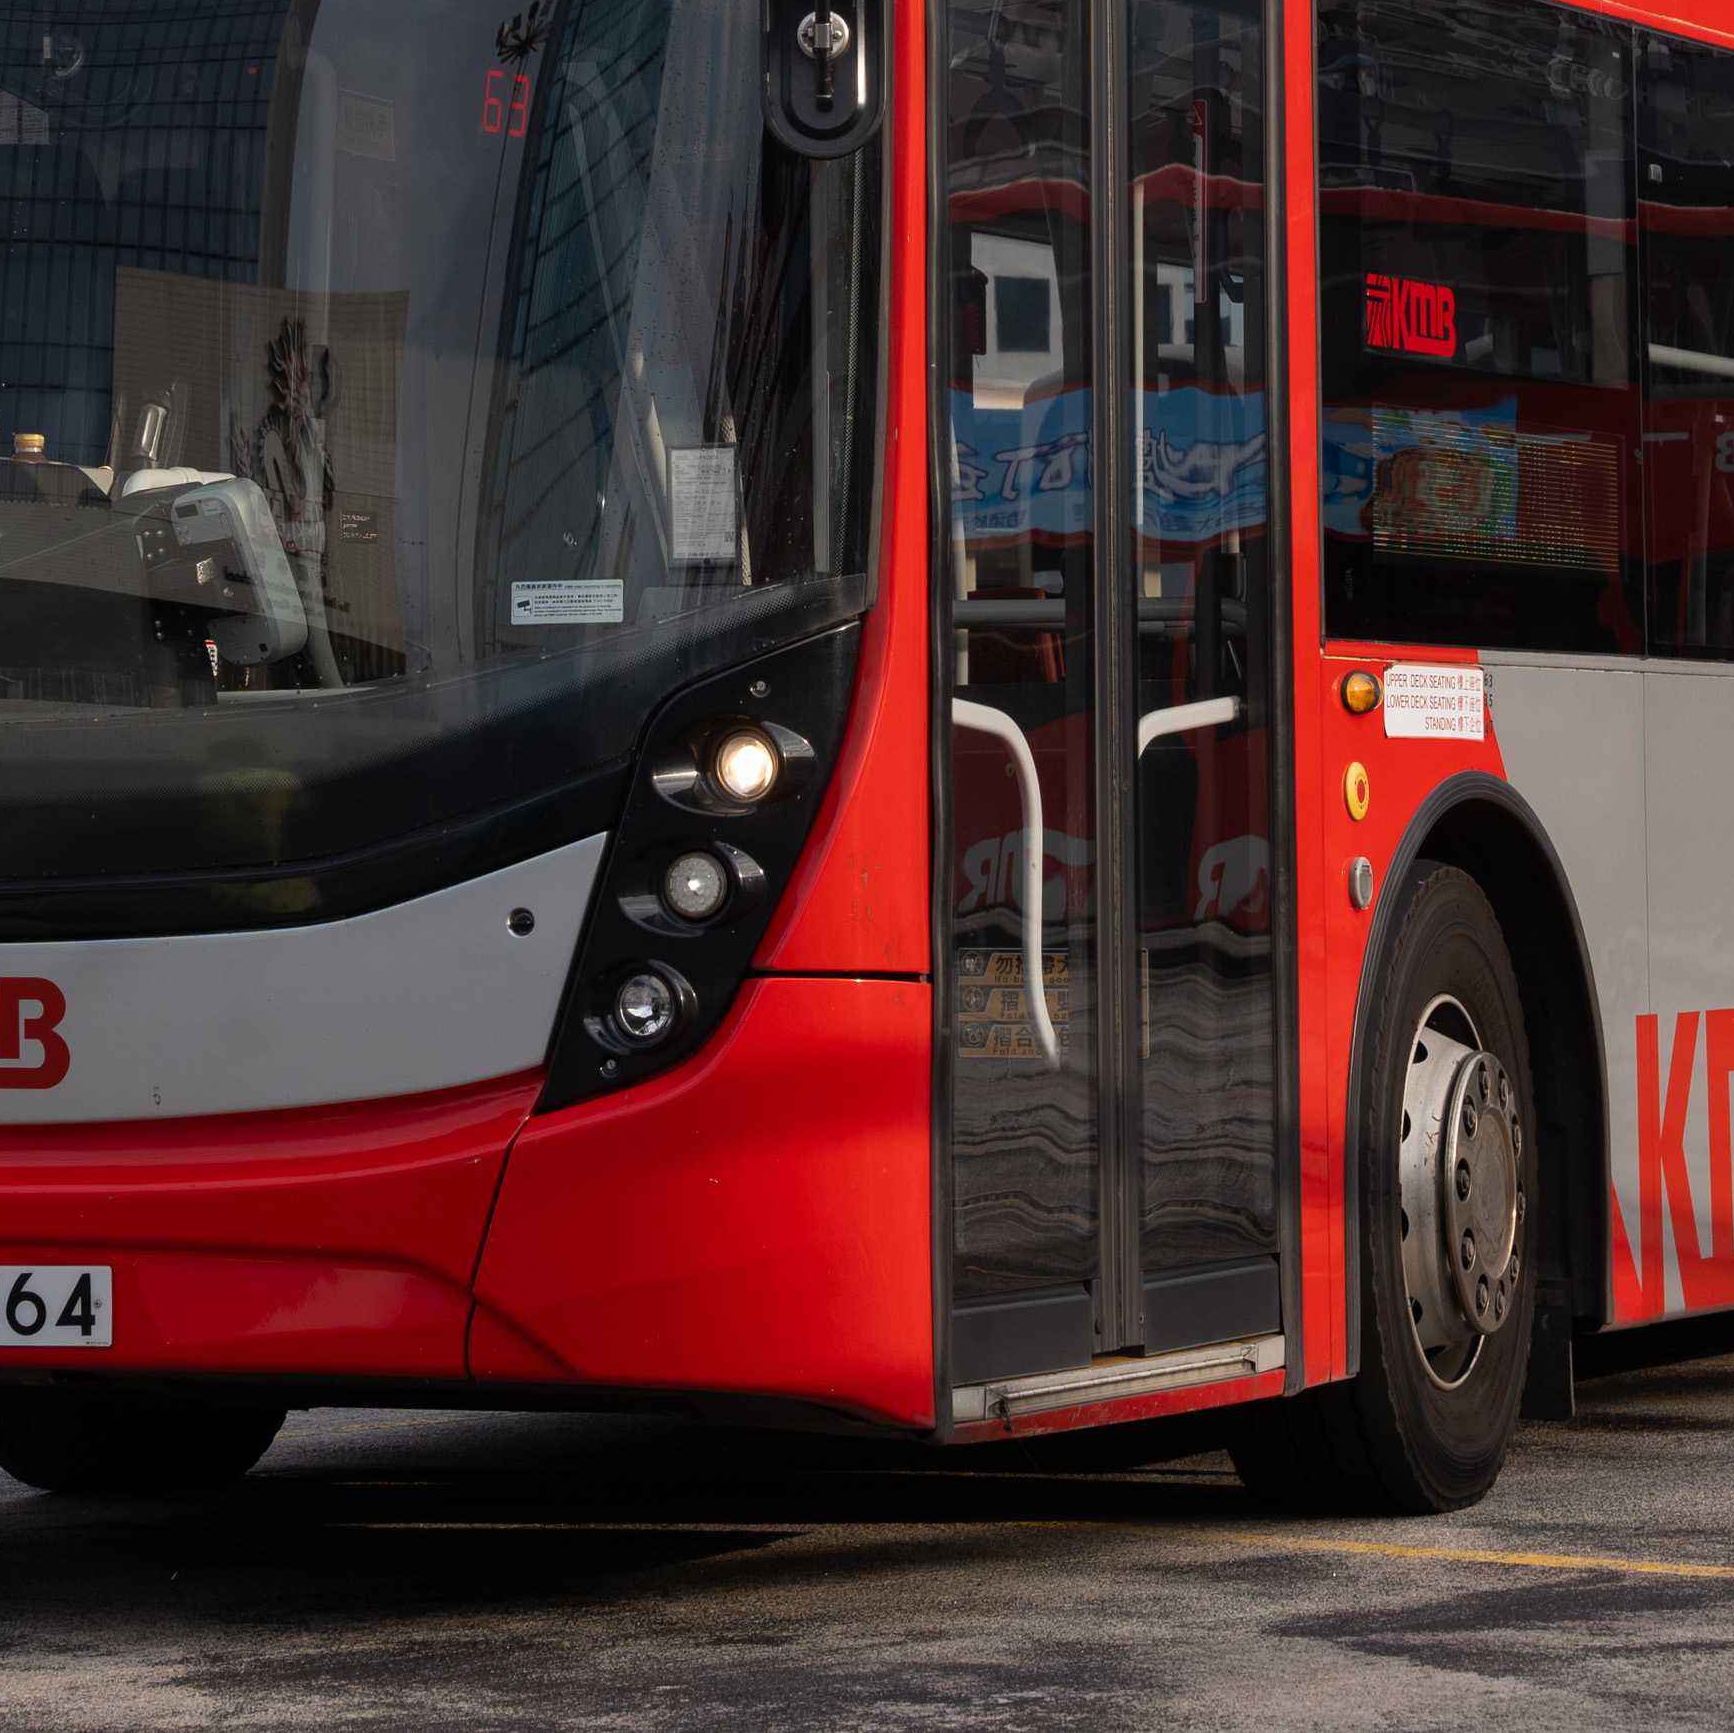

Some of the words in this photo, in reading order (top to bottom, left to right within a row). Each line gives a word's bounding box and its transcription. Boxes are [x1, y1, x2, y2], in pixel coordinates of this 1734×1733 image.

[480, 69, 531, 138] 63
[1391, 275, 1457, 357] KMB
[1386, 673, 1408, 688] UPPER
[1411, 674, 1428, 688] DECK
[1429, 674, 1456, 690] SEATING
[1386, 694, 1410, 710] LOWER
[1411, 695, 1428, 710] DECK
[1429, 695, 1456, 711] SEATING
[1425, 715, 1456, 731] STANDING
